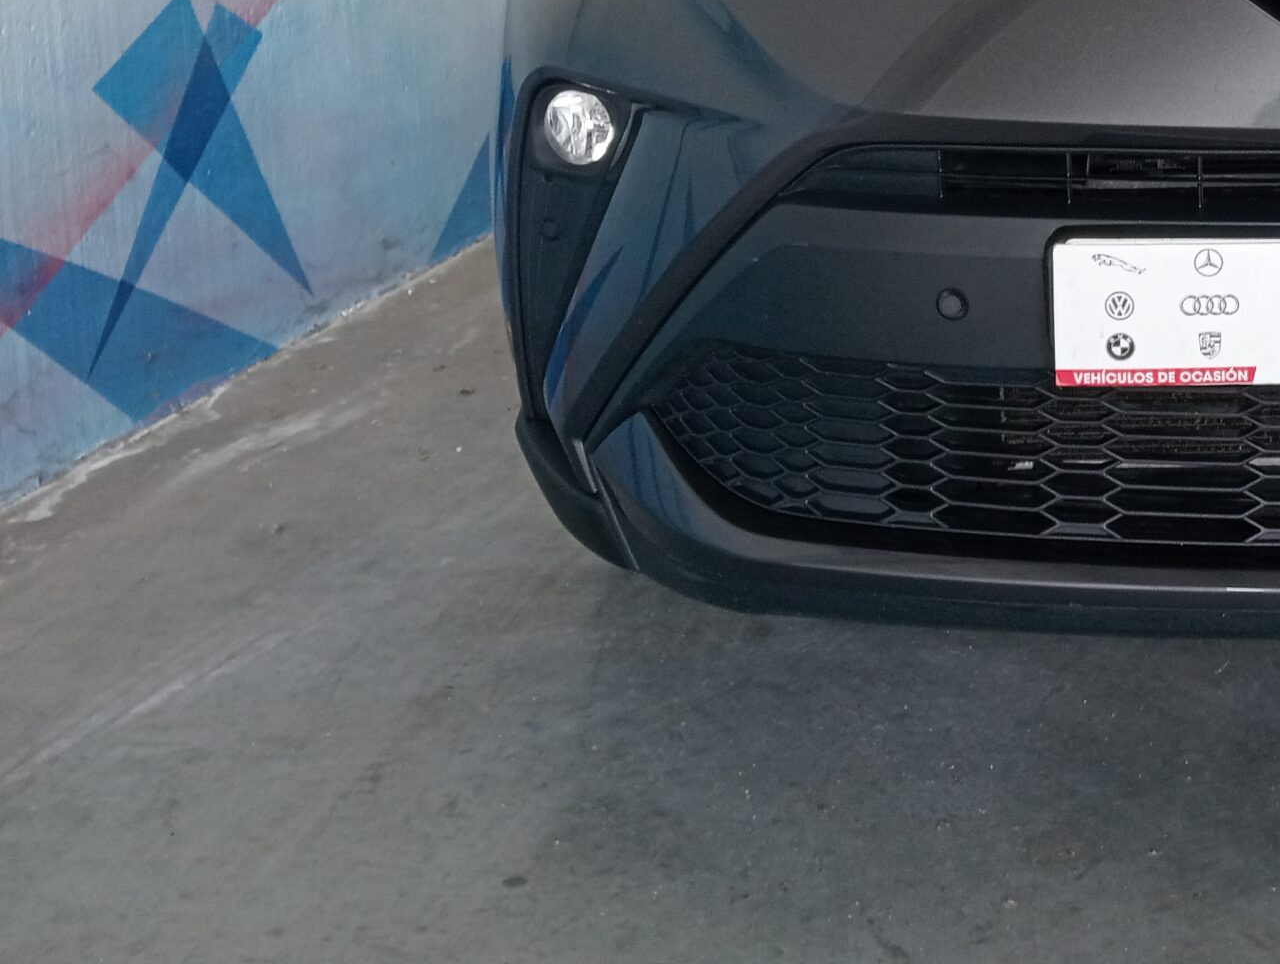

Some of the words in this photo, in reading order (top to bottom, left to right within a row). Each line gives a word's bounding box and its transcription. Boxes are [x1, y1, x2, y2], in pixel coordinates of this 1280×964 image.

[1073, 369, 1154, 385] VEHÍCULOS
[1158, 371, 1175, 384] DE
[1179, 367, 1248, 384] OCASIÓN
